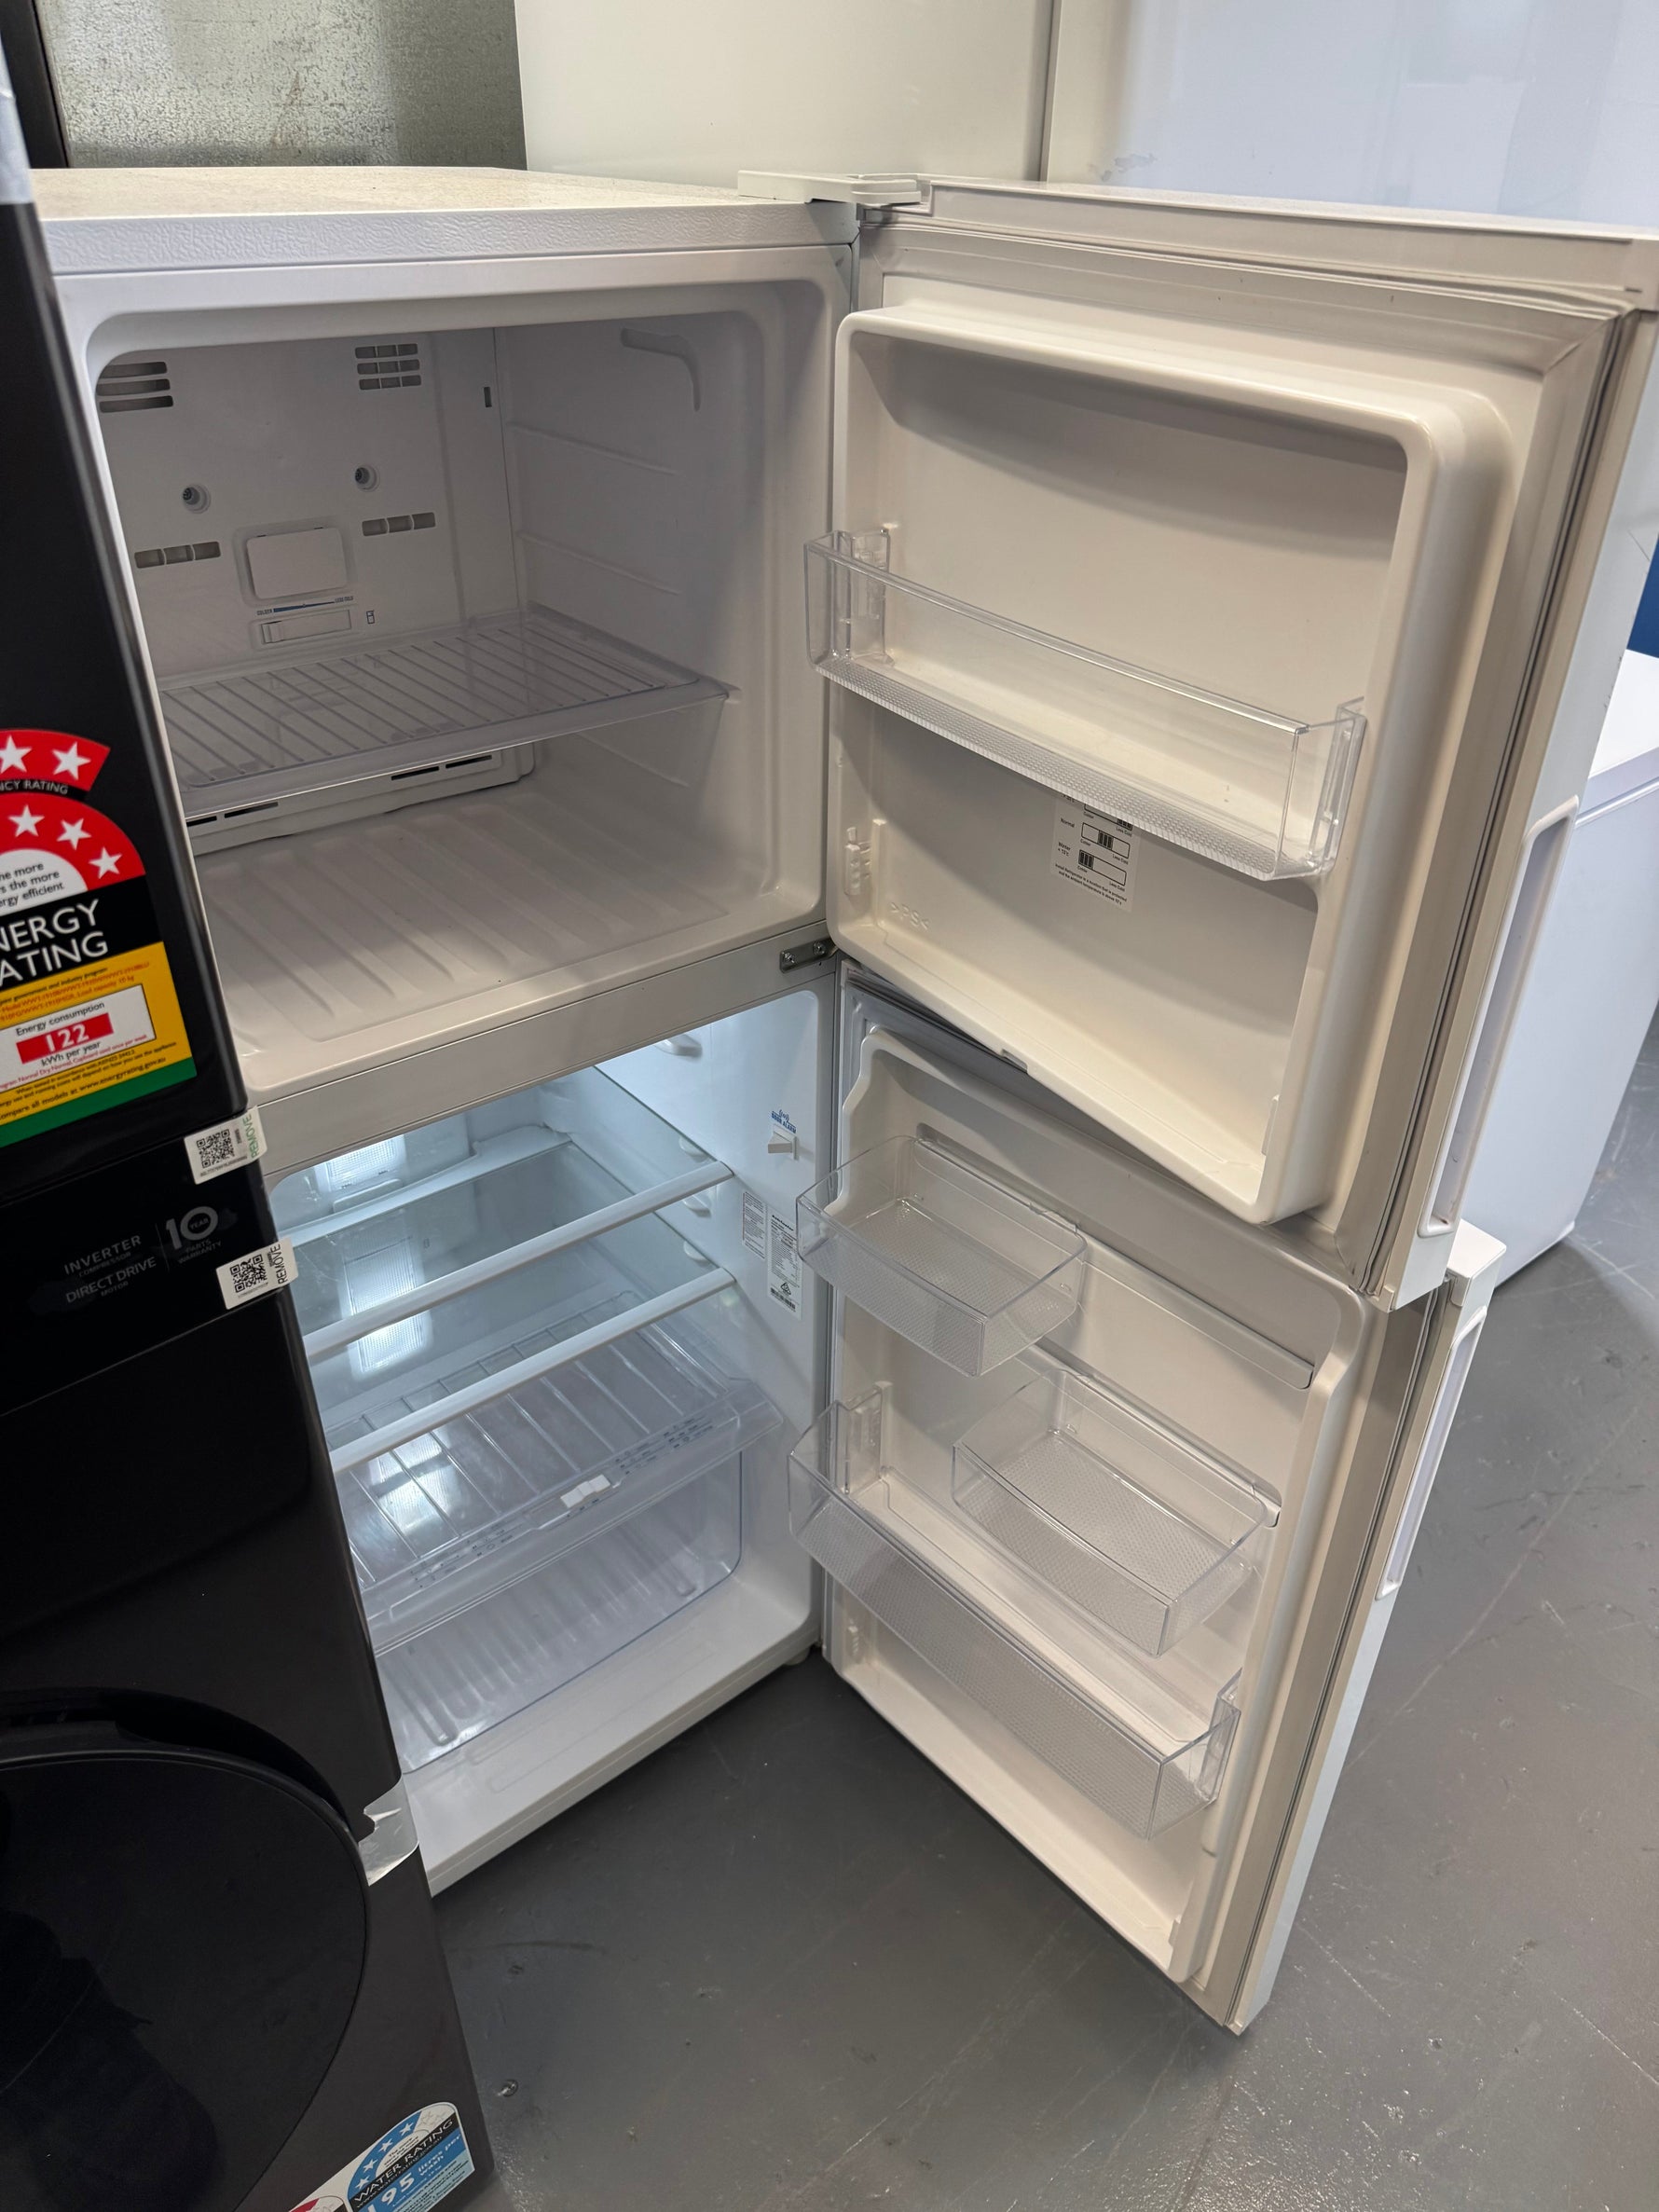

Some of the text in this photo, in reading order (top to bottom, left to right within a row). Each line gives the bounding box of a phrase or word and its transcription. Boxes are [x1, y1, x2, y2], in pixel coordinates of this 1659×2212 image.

[23, 779, 68, 794] RATING
[9, 880, 27, 891] the
[30, 872, 60, 886] more
[14, 863, 45, 877] more
[22, 882, 64, 900] efficient
[16, 1020, 48, 1037] Energy
[48, 1002, 105, 1025] consumption
[46, 1024, 89, 1052] 122
[41, 1041, 101, 1066] kWh per year
[32, 1099, 40, 1108] all
[42, 1092, 69, 1105] models
[242, 1113, 260, 1159] REMOVE
[166, 1206, 219, 1250] 10
[64, 1235, 142, 1275] INVERTER
[270, 1243, 289, 1285] REMOVE
[65, 1257, 157, 1303] DIRECT DRIVE
[101, 1281, 129, 1297] MOTOR
[445, 2133, 461, 2151] per
[354, 2163, 402, 2202] WATER
[404, 2119, 453, 2163] RATING
[419, 2154, 445, 2177] wash
